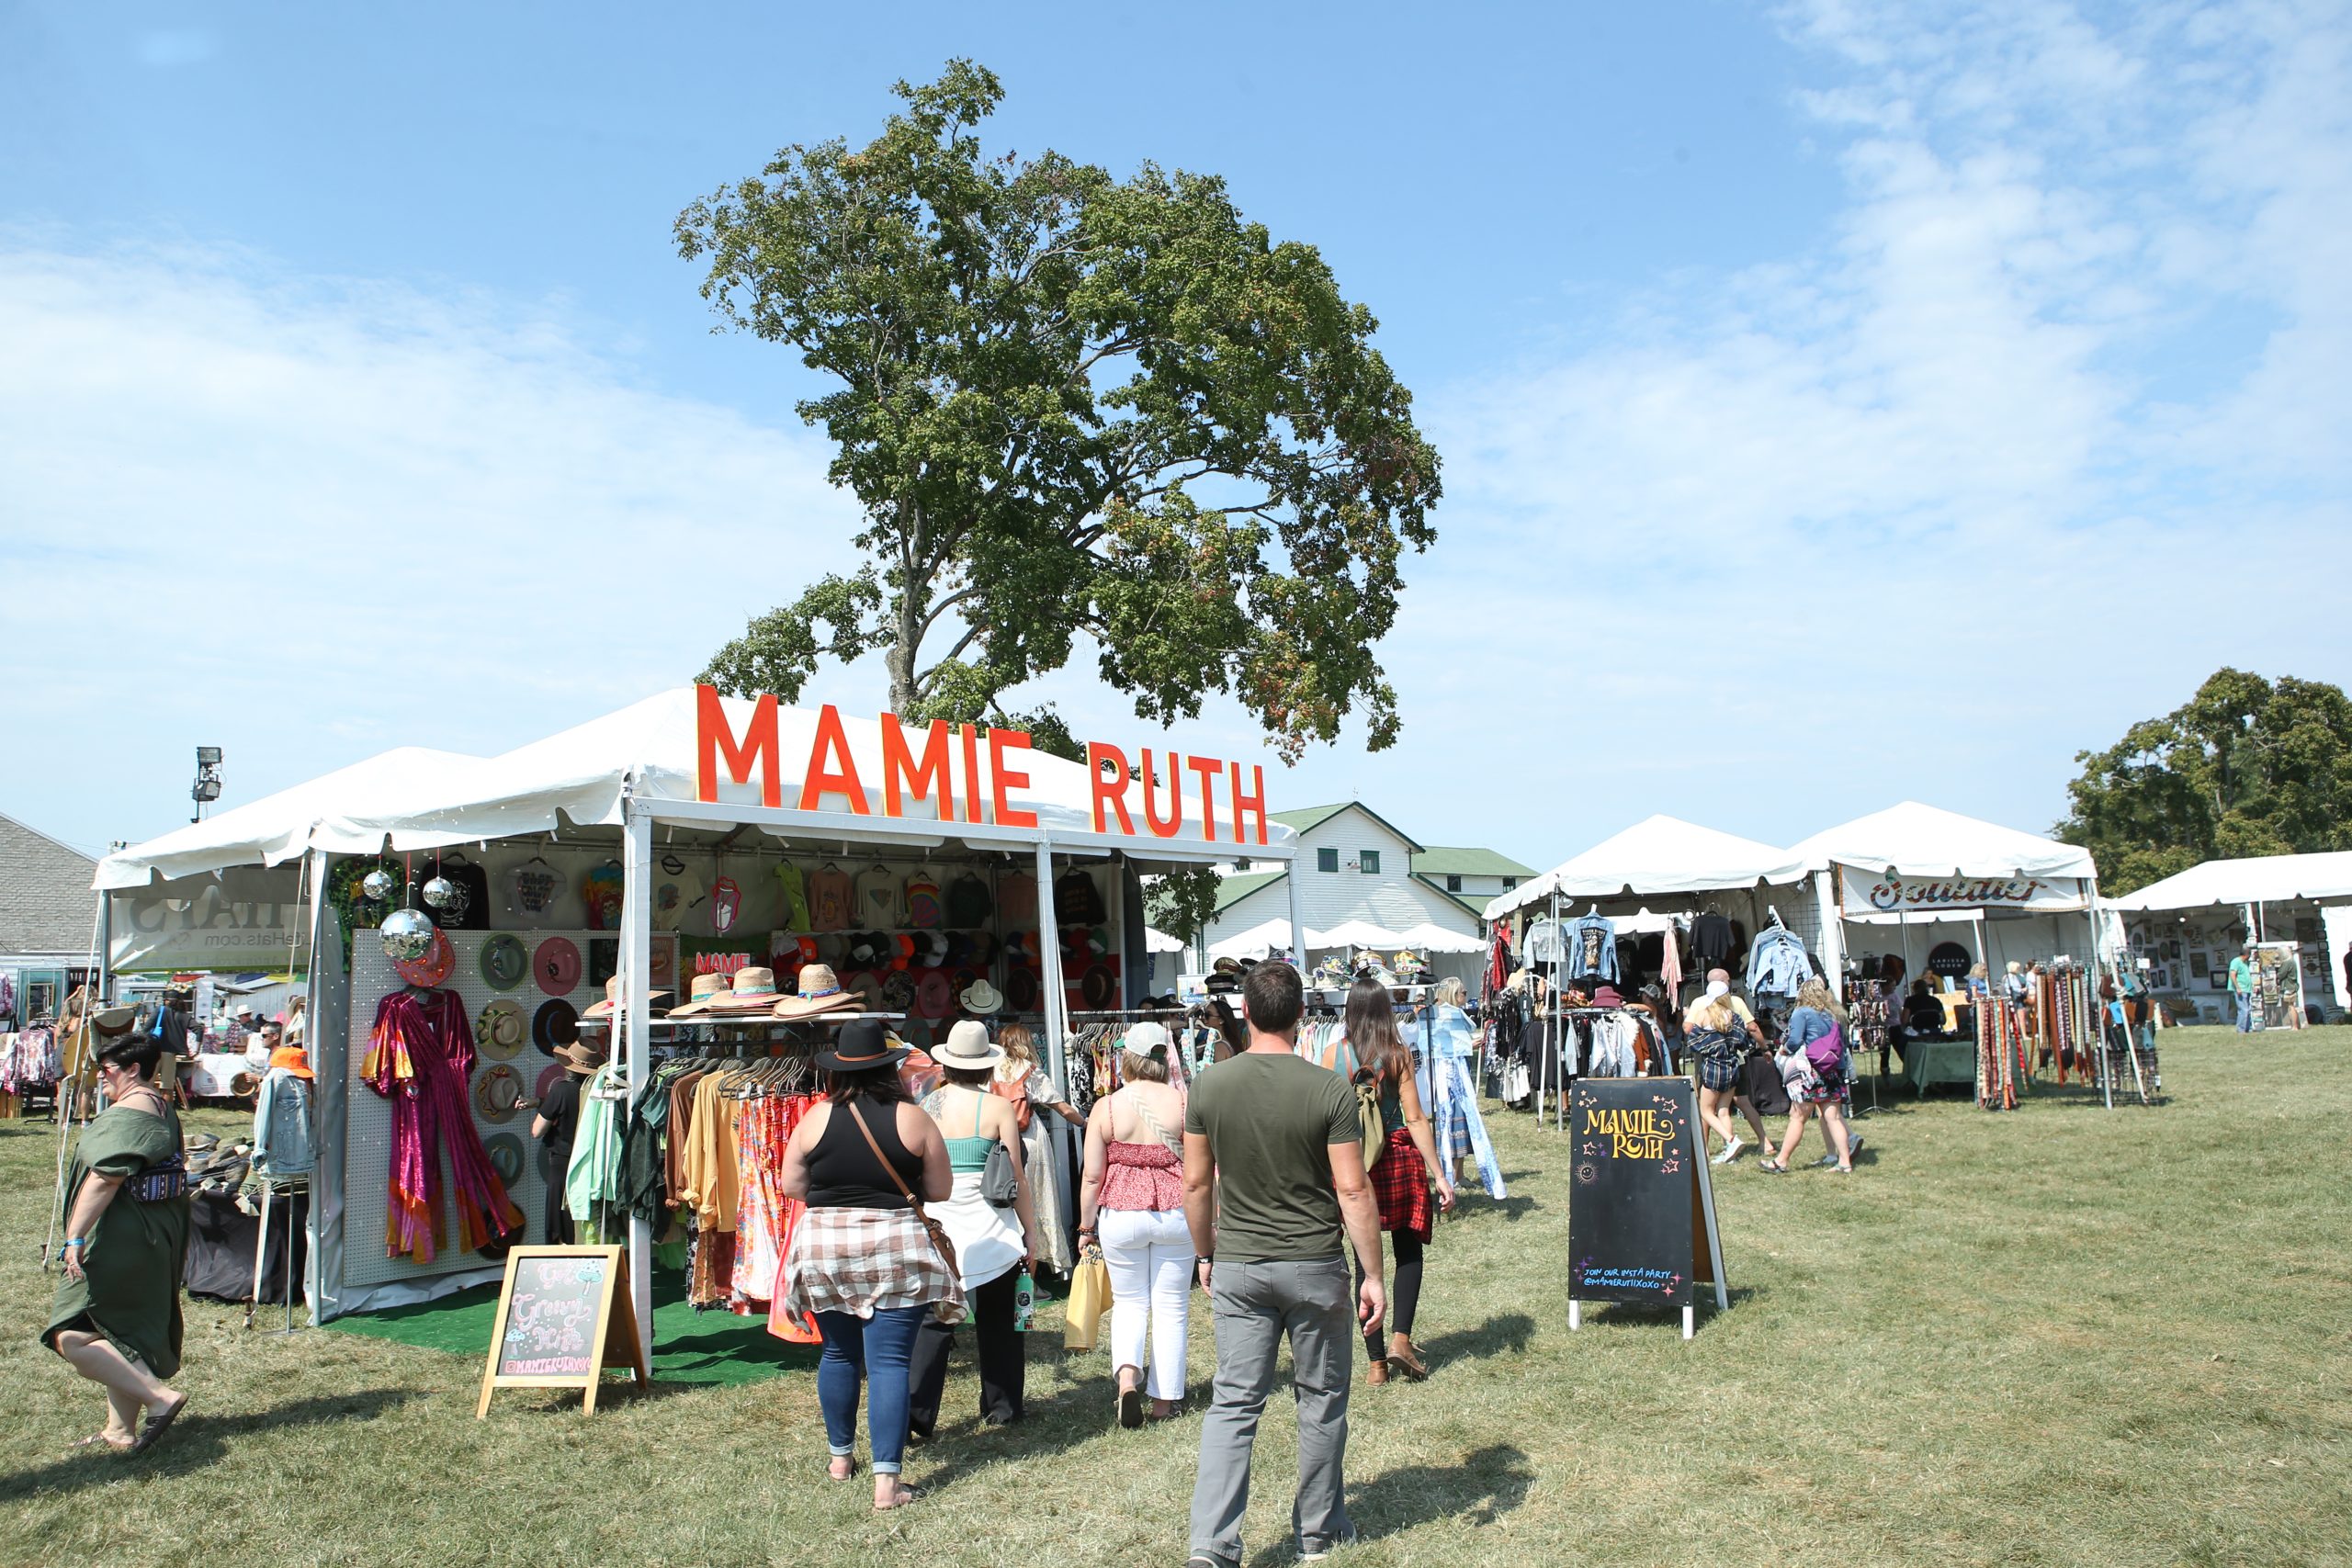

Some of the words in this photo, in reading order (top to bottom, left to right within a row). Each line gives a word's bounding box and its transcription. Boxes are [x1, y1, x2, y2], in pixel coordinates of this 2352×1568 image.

[695, 684, 1038, 828] MAMIE
[1086, 741, 1269, 845] RUTH
[695, 952, 750, 974] MAMIE
[1583, 1110, 1673, 1137] MAMIE
[1611, 1132, 1676, 1159] RUTH
[1584, 1268, 1602, 1276] JOIN
[1604, 1269, 1619, 1277] OUR
[1621, 1268, 1644, 1277] INSTA
[1645, 1269, 1671, 1279] PARTY
